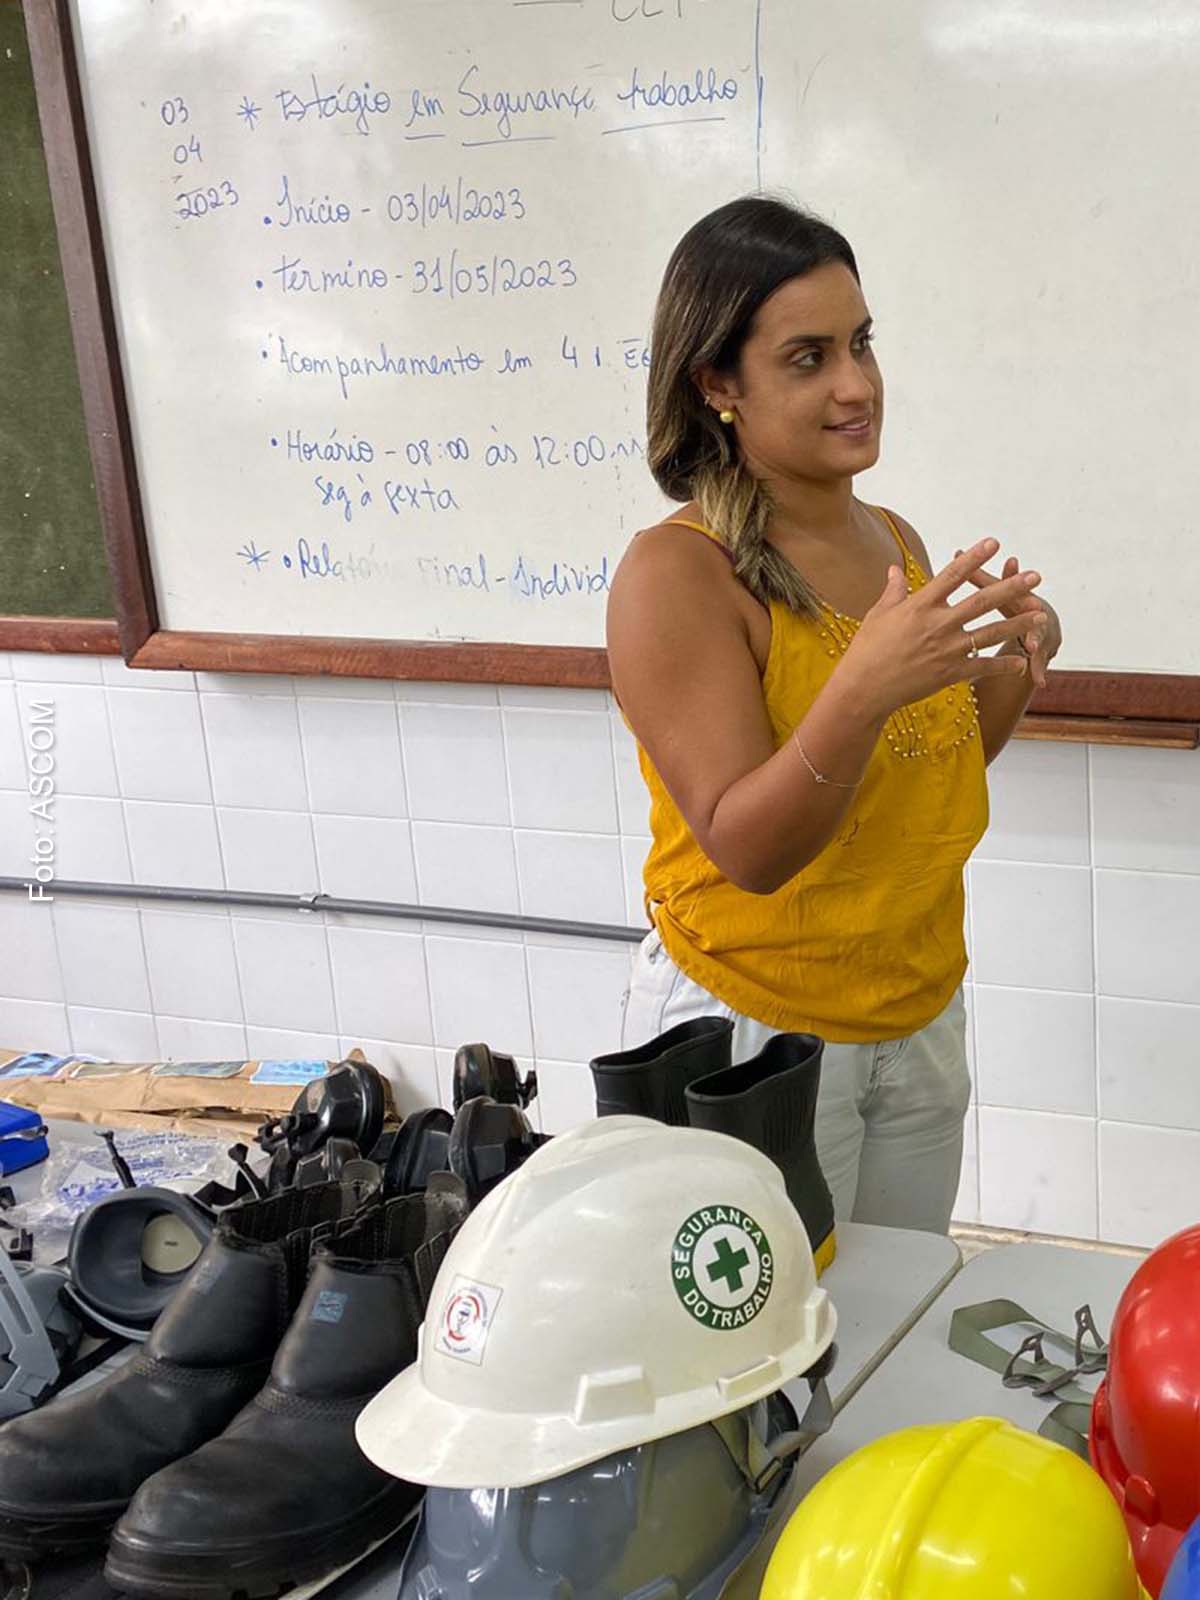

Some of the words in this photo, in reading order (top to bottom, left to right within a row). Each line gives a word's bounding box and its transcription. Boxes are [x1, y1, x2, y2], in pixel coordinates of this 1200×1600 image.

[160, 96, 190, 126] 03
[275, 73, 392, 136] Estágio
[404, 89, 445, 128] em
[617, 67, 738, 111] trabalho
[173, 133, 204, 165] 04
[174, 180, 239, 220] 2023
[387, 175, 527, 229] 03/04/2023
[411, 248, 577, 300] 31/05/2023
[278, 335, 484, 400] Acompanhamento
[497, 348, 532, 373] em
[286, 427, 375, 464] Horário
[405, 438, 470, 467] 08:00
[673, 1206, 763, 1280] SEGURANÇA
[682, 1288, 709, 1318] DO
[710, 1252, 773, 1328] TRABALHO
